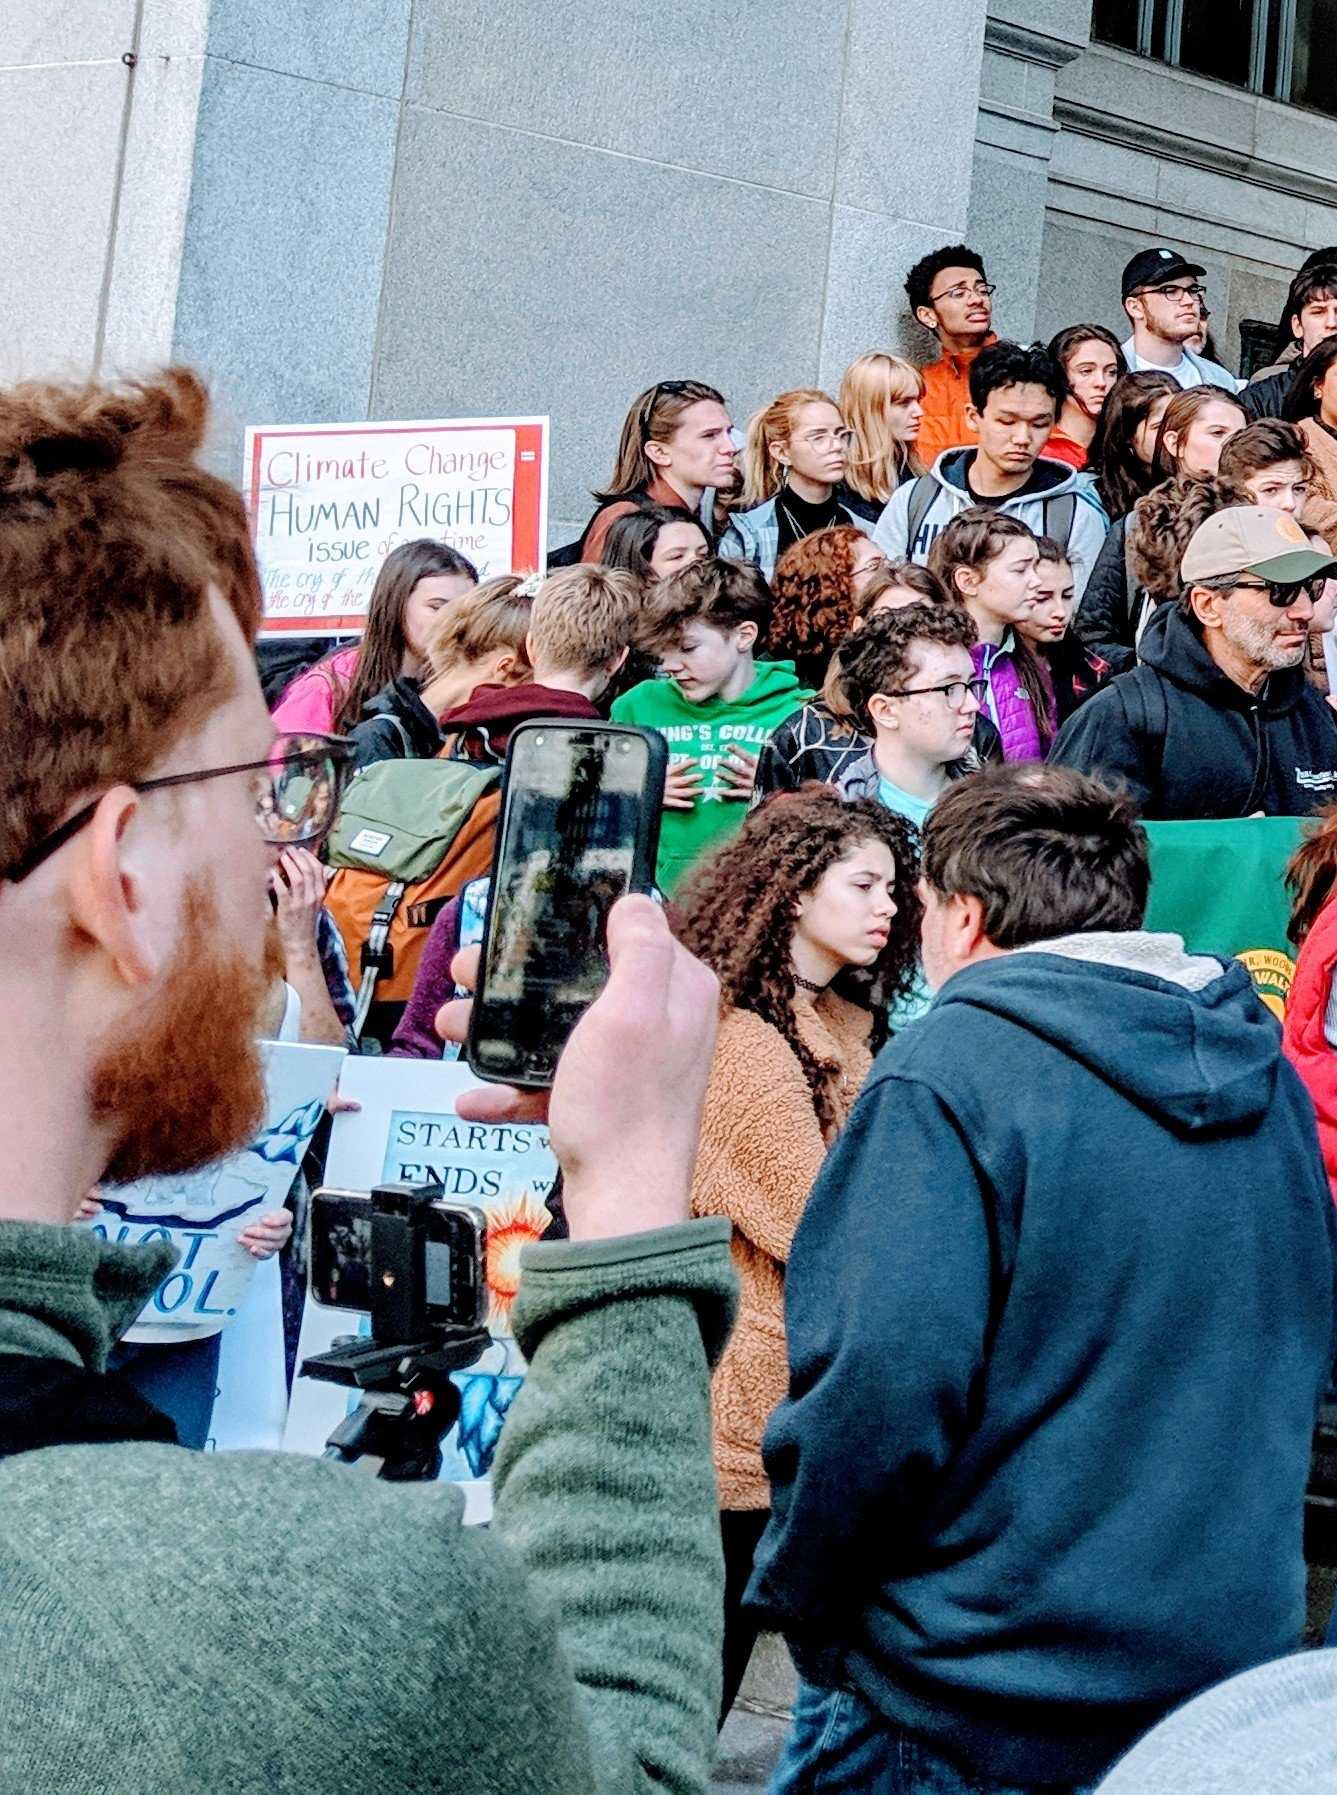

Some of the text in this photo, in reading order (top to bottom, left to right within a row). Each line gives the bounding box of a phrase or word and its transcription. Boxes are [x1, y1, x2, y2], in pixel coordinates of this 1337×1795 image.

[267, 443, 511, 487] Climate Change
[268, 482, 512, 537] HUMAN RIGHTS
[308, 537, 371, 563] issue
[656, 724, 712, 742] ING'S
[396, 1119, 533, 1154] STARTS
[153, 1269, 237, 1316] OL.
